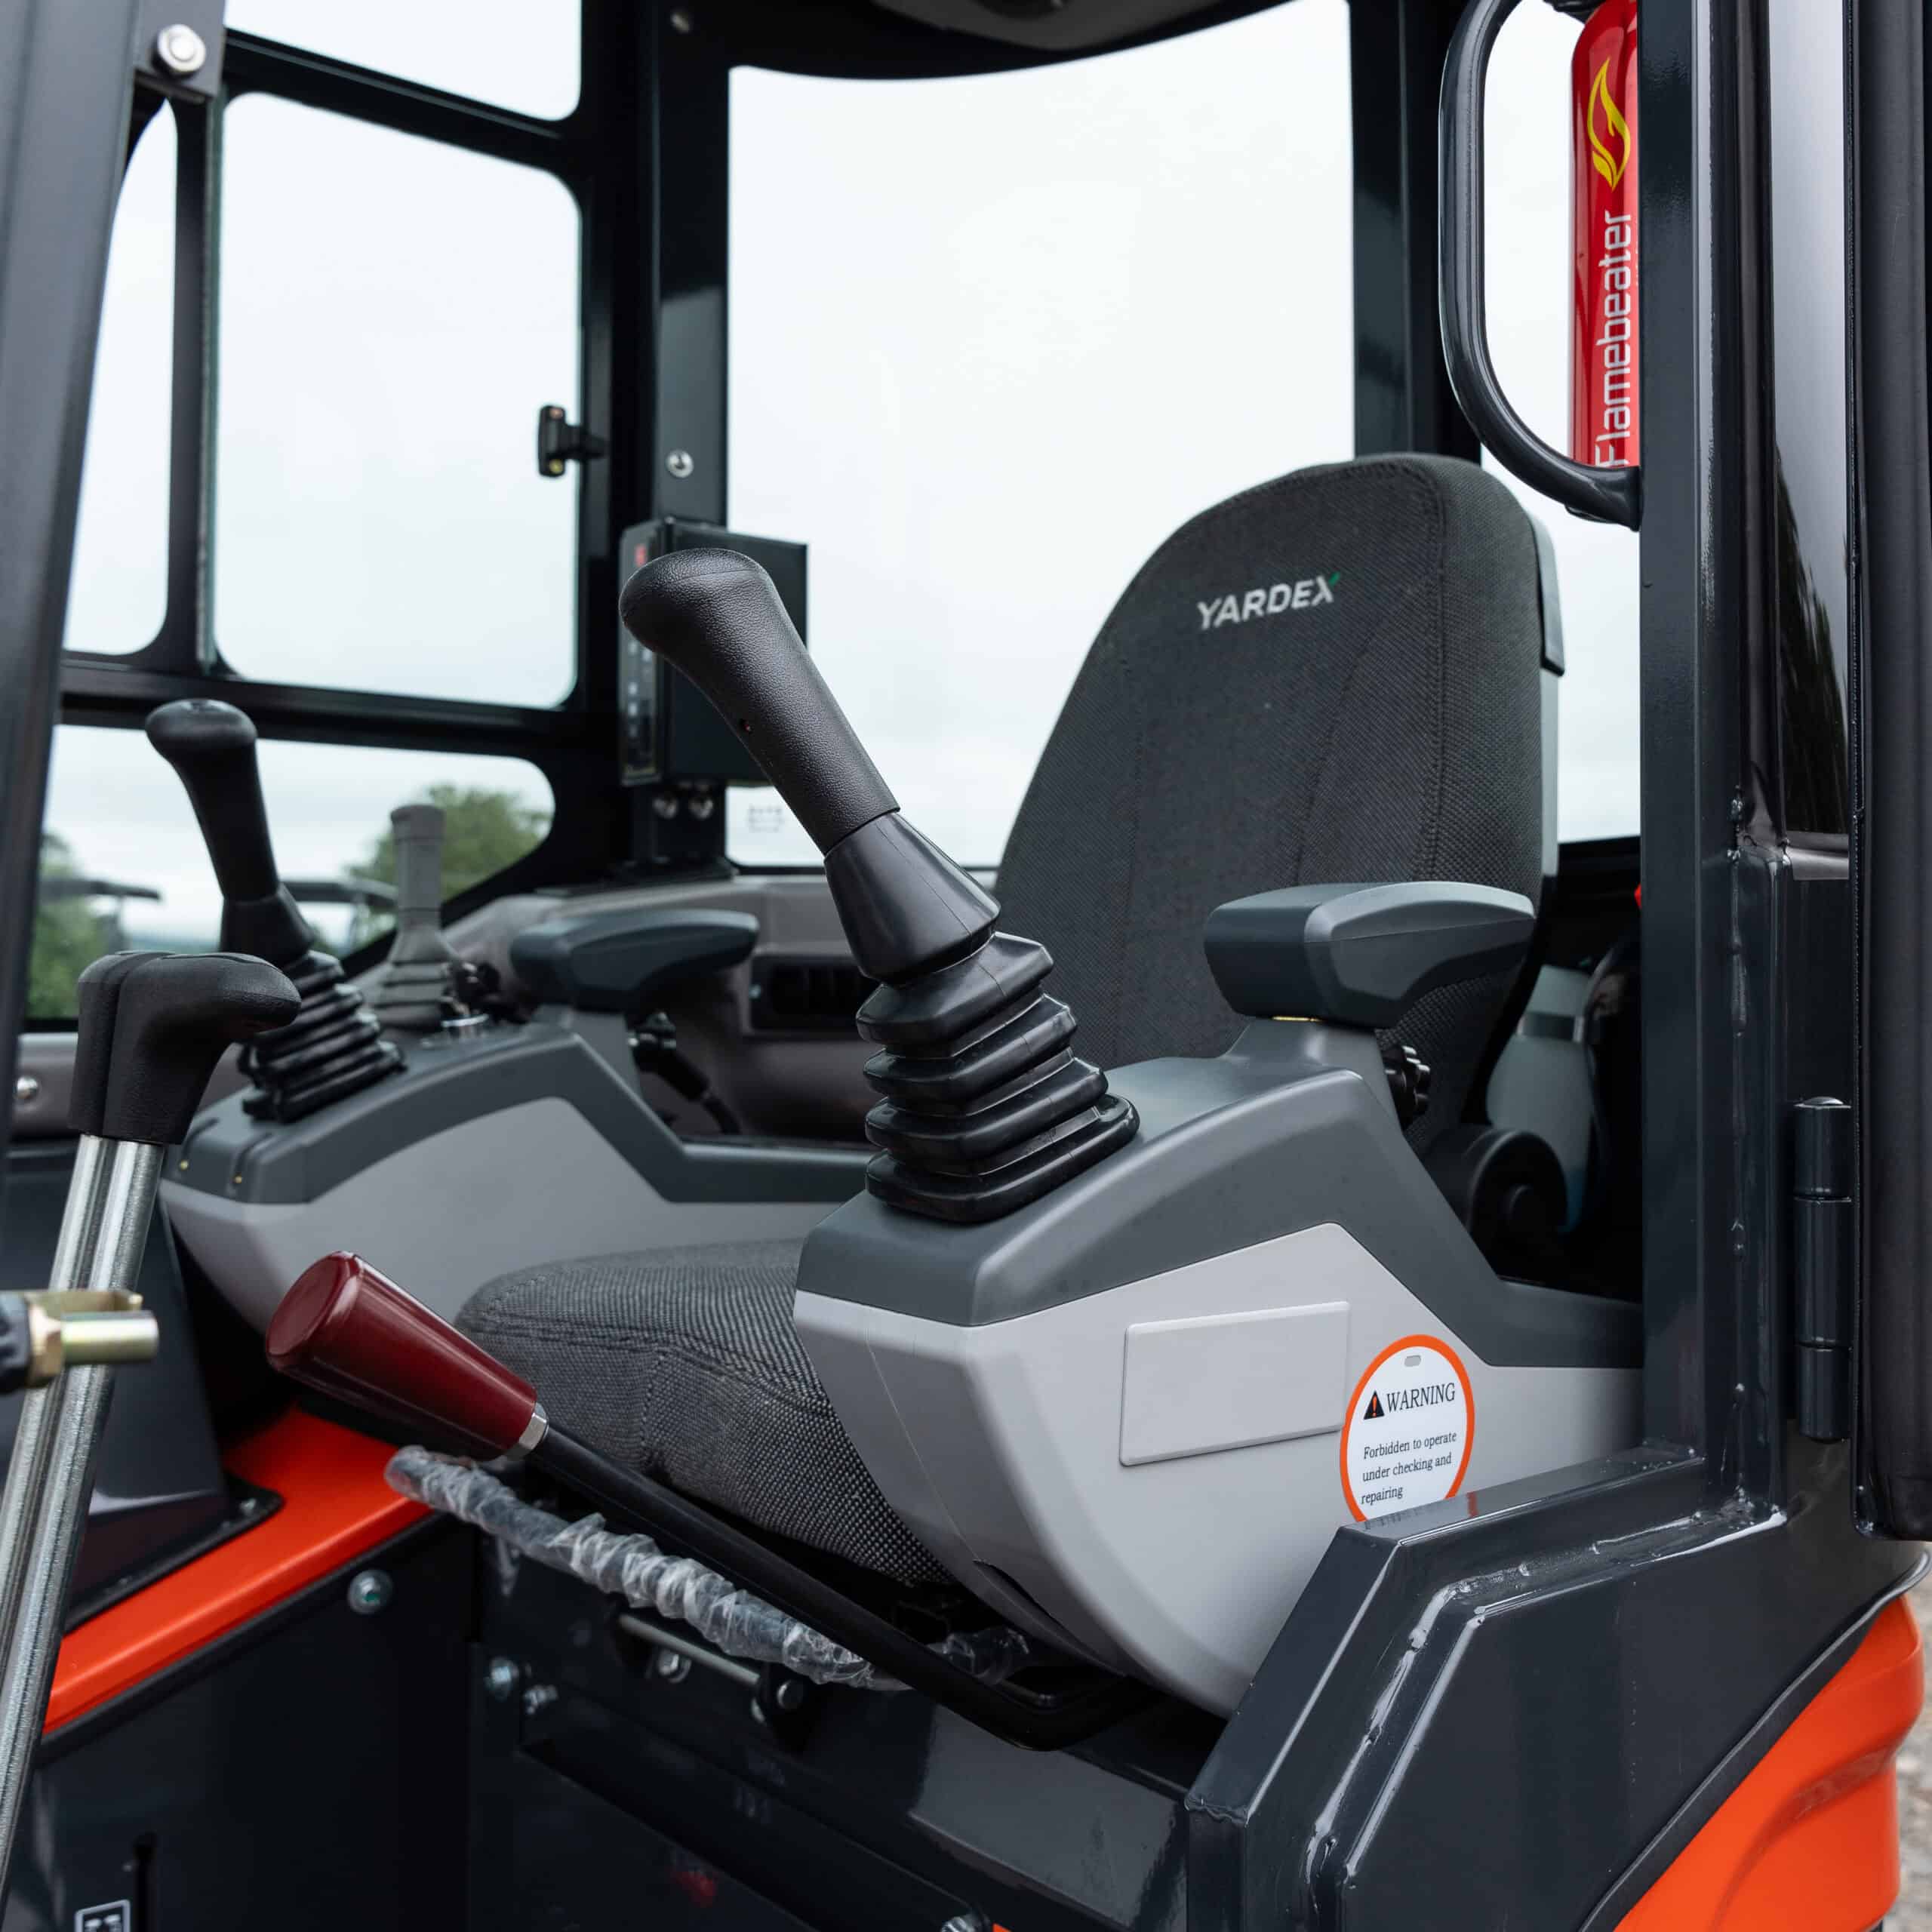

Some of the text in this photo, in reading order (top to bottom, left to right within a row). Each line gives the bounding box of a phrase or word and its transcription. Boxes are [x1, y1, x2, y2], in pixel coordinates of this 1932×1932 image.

[1595, 209, 1631, 468] Flamebeater
[1197, 572, 1340, 630] YARDEX
[1386, 1382, 1456, 1414] WARNING
[1364, 1432, 1457, 1460] Forbidden to operate
[1362, 1451, 1452, 1482] under checking and
[1361, 1486, 1404, 1506] repairing
